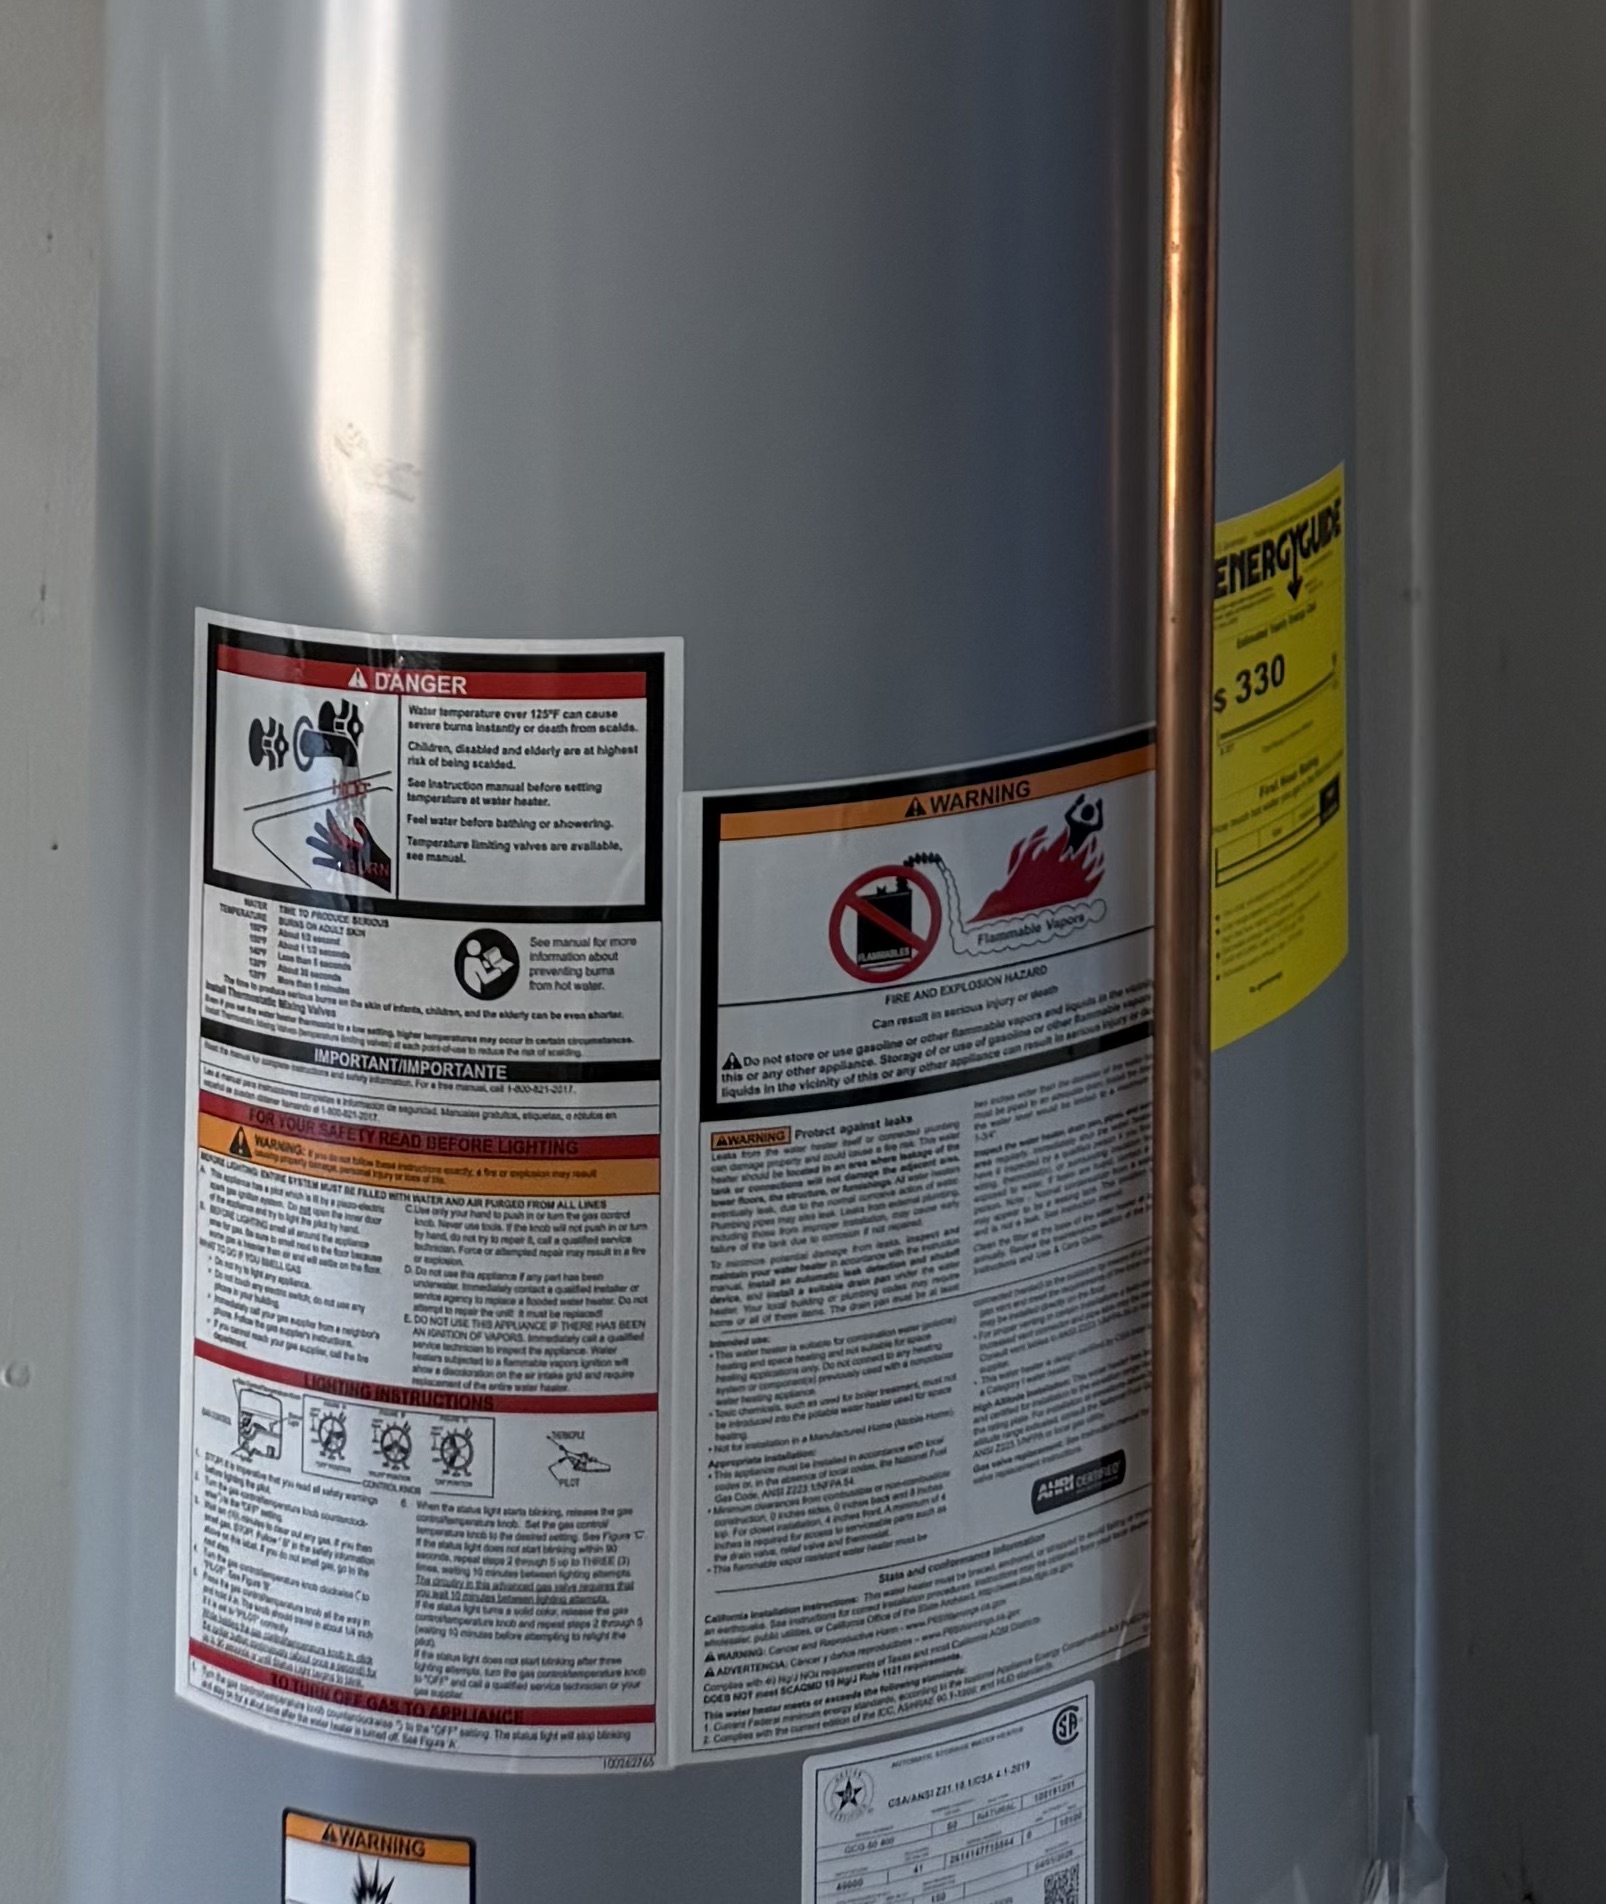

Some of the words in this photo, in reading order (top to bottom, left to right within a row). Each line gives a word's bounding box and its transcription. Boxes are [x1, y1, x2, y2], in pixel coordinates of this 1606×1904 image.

[374, 671, 468, 696] DANGER
[1235, 653, 1286, 705] 330
[929, 780, 1032, 811] WARNING
[529, 936, 550, 948] See
[552, 936, 591, 948] manual
[592, 936, 608, 948] for
[609, 937, 638, 948] more
[977, 922, 1041, 946] Flammable
[1046, 913, 1086, 932] Vapors
[529, 951, 587, 962] information
[588, 951, 619, 962] about
[529, 966, 583, 979] preventing
[585, 966, 616, 977] burns
[528, 980, 553, 991] from
[554, 980, 572, 991] hot
[573, 981, 605, 992] water.
[884, 990, 911, 1005] FIRE
[912, 985, 938, 1001] AND
[940, 974, 1003, 997] EXPLOSION
[1004, 964, 1049, 985] HAZARD
[871, 1017, 895, 1030] Can
[896, 1012, 929, 1026] result
[931, 1009, 943, 1021] in
[944, 1003, 984, 1018] serious
[985, 995, 1016, 1012] injury
[1017, 992, 1030, 1002] or
[1030, 984, 1060, 1000] death
[742, 1056, 760, 1067] Do
[762, 1053, 783, 1065] not
[785, 1050, 816, 1064] store
[817, 1050, 831, 1059] or
[832, 1046, 854, 1058] use
[855, 1039, 904, 1056] gasoline
[905, 1036, 918, 1046] or
[920, 1031, 950, 1045] other
[951, 1019, 1007, 1038] flammable
[1007, 1010, 1043, 1029] vapors
[1044, 1004, 1064, 1018] and
[1064, 995, 1098, 1012] liquids
[314, 1048, 508, 1080] IMPORTANT/IMPORTANTE
[721, 1071, 744, 1083] this
[746, 1071, 760, 1081] or
[762, 1068, 783, 1083] any
[785, 1065, 817, 1078] other
[818, 1058, 876, 1075] appliance.
[879, 1049, 923, 1066] Storage
[924, 1045, 938, 1057] of
[938, 1044, 952, 1054] or
[953, 1041, 974, 1053] use
[975, 1035, 987, 1048] of
[987, 1027, 1032, 1047] gasoline
[720, 1084, 762, 1099] liquids
[763, 1083, 776, 1094] in
[777, 1081, 797, 1093] the
[798, 1076, 841, 1091] vicinity
[842, 1073, 856, 1085] of
[857, 1069, 880, 1082] this
[881, 1068, 895, 1079] or
[896, 1064, 918, 1079] any
[919, 1057, 948, 1073] other
[948, 1049, 1002, 1068] appliance
[248, 1107, 275, 1128] FOR
[280, 1115, 315, 1134] YOUR
[318, 1124, 379, 1144] SAFETY
[380, 1130, 421, 1149] READ
[426, 1135, 494, 1154] BEFORE
[498, 1135, 580, 1155] LIGHTING
[727, 1130, 786, 1146] WARNING
[794, 1125, 836, 1140] Protect
[839, 1119, 882, 1136] against
[883, 1114, 914, 1128] leaks
[340, 1827, 427, 1859] WARNING
